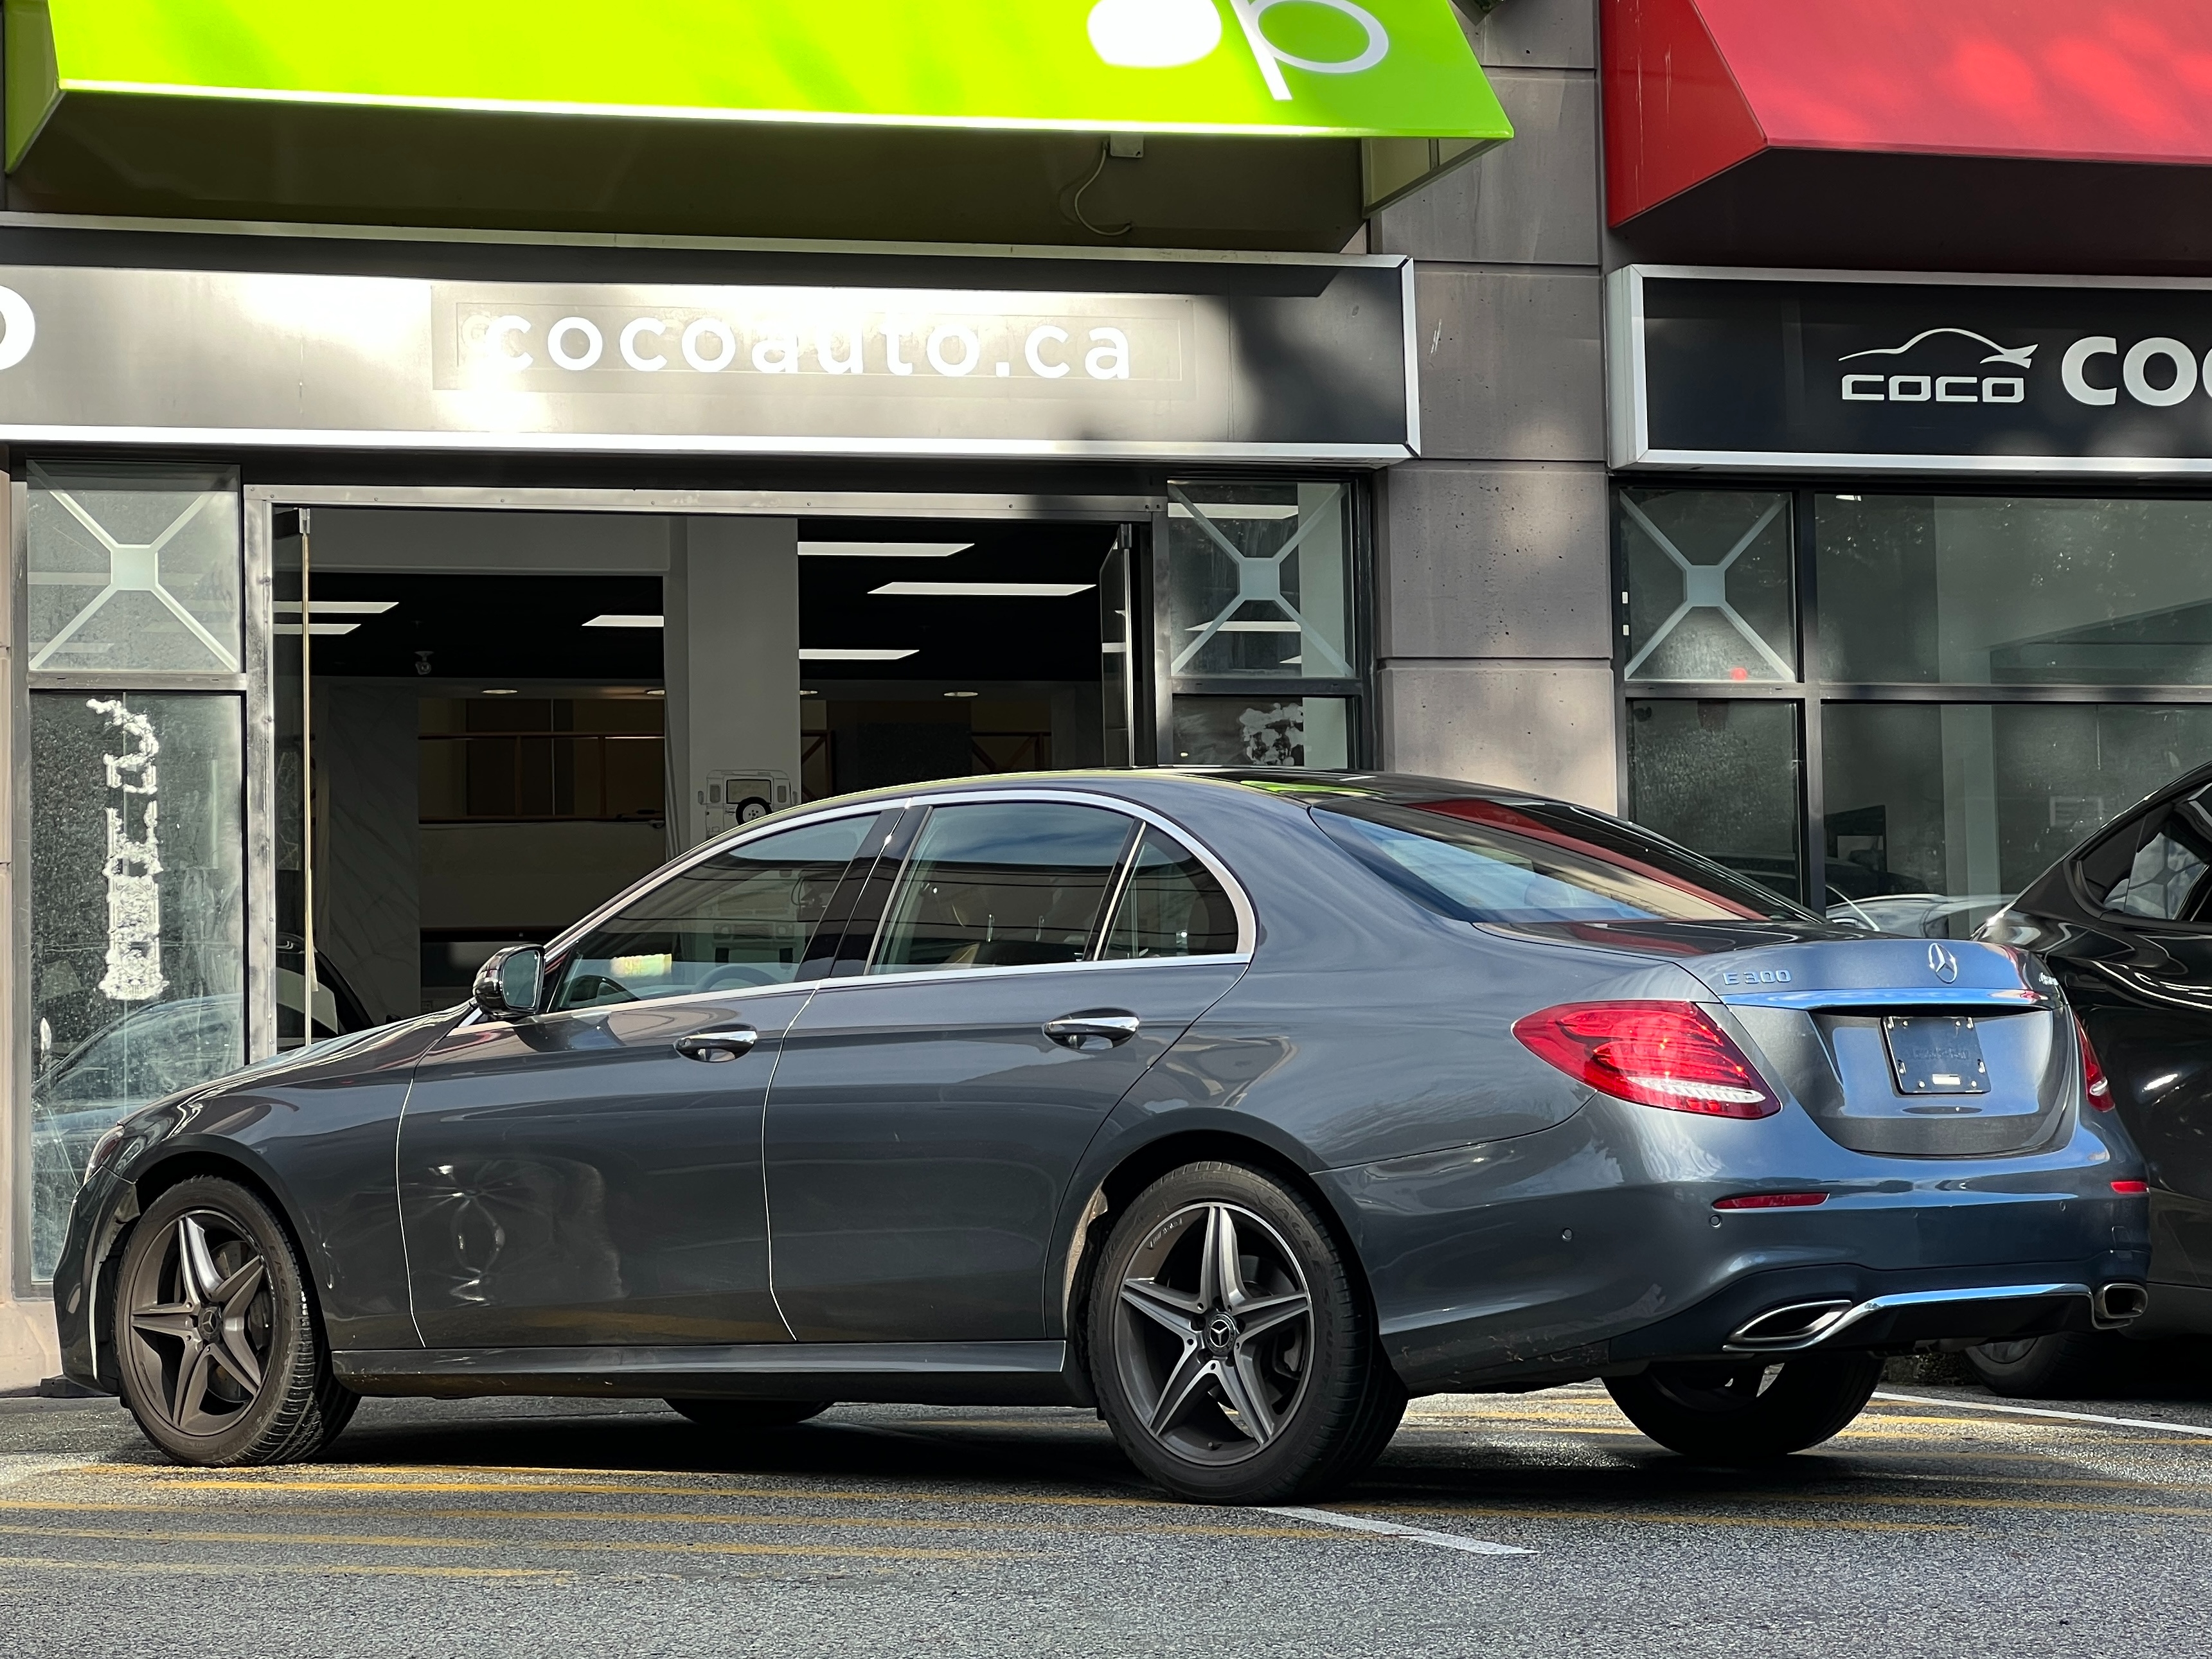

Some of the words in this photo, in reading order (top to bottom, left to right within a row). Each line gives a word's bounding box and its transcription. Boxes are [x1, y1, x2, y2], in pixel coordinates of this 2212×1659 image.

[485, 310, 1130, 380] cocoauto.ca
[2062, 335, 2212, 406] CO
[1842, 374, 2024, 403] COCO
[1723, 972, 1740, 985] E
[1743, 970, 1792, 984] 300
[1267, 1195, 1326, 1275] EAGLE
